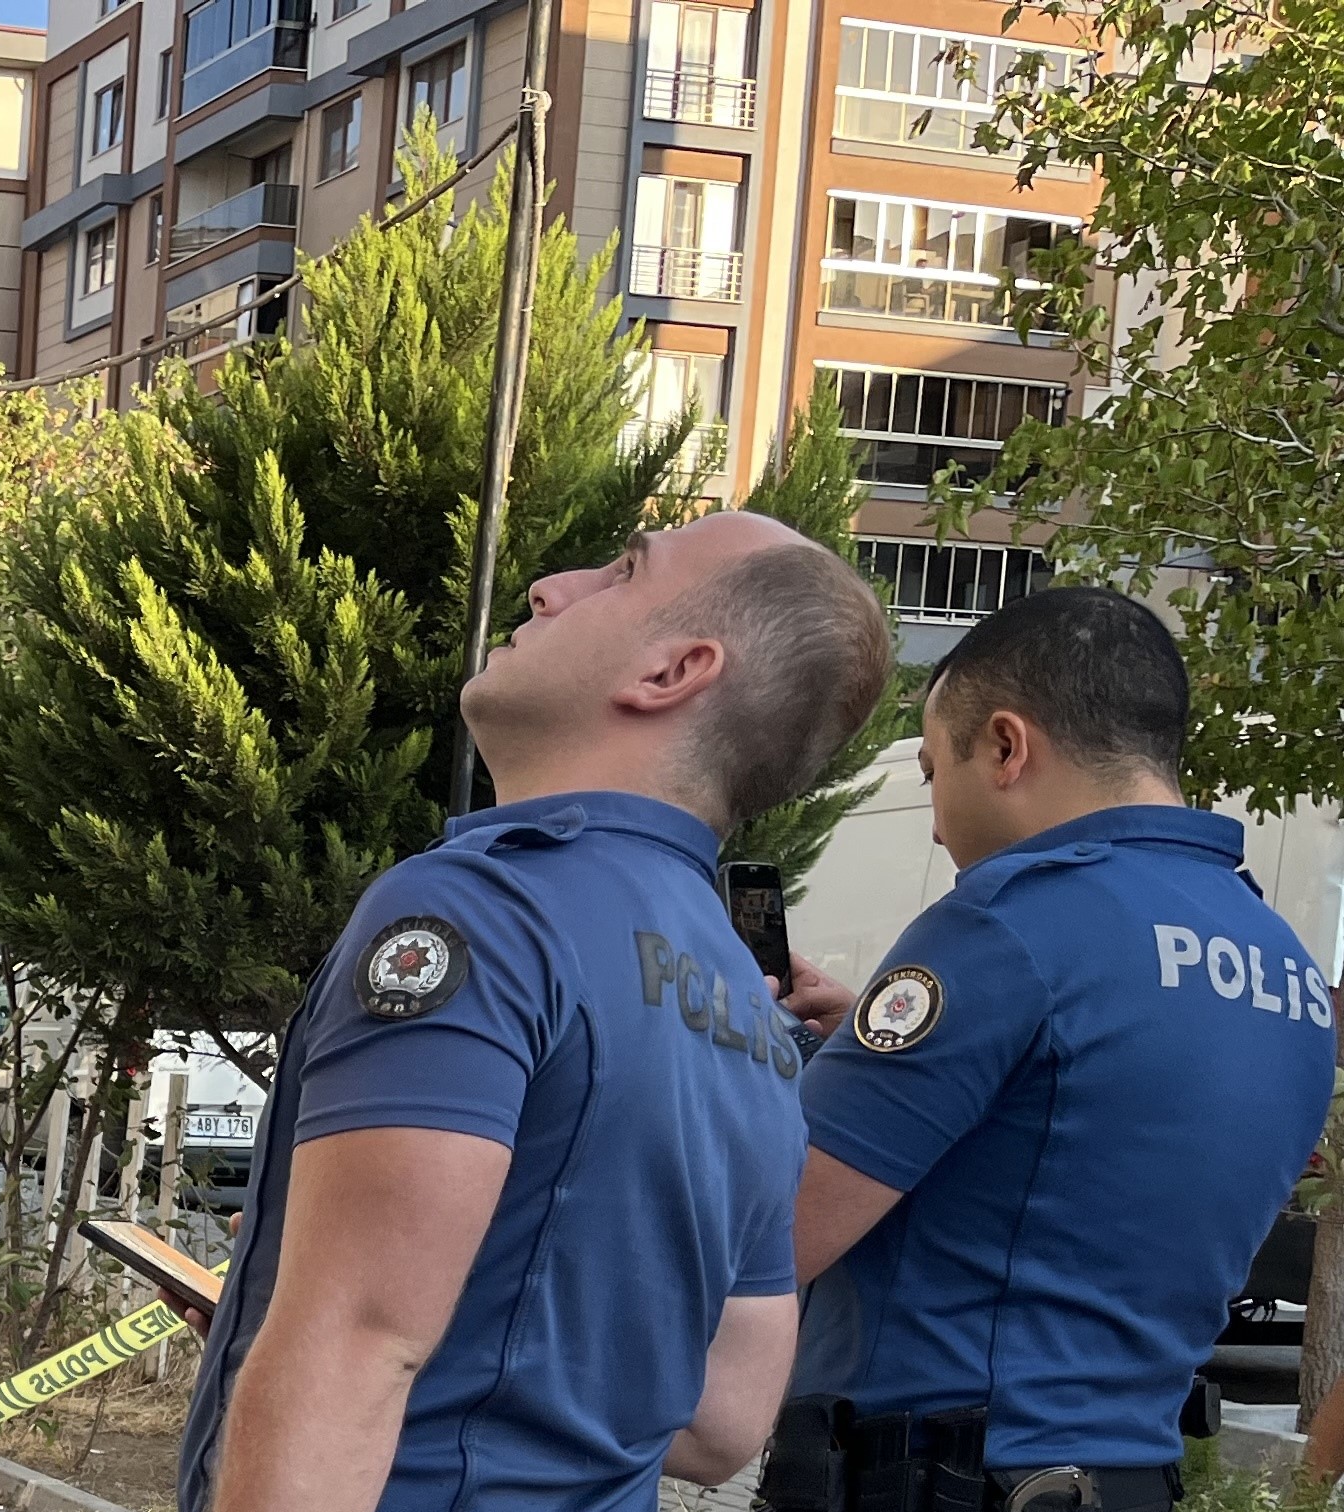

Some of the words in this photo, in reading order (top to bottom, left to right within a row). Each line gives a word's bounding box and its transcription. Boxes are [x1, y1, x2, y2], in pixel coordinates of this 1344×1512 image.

[632, 930, 798, 1080] POLİS
[1153, 924, 1332, 1029] POLİS
[227, 1118, 249, 1133] 176
